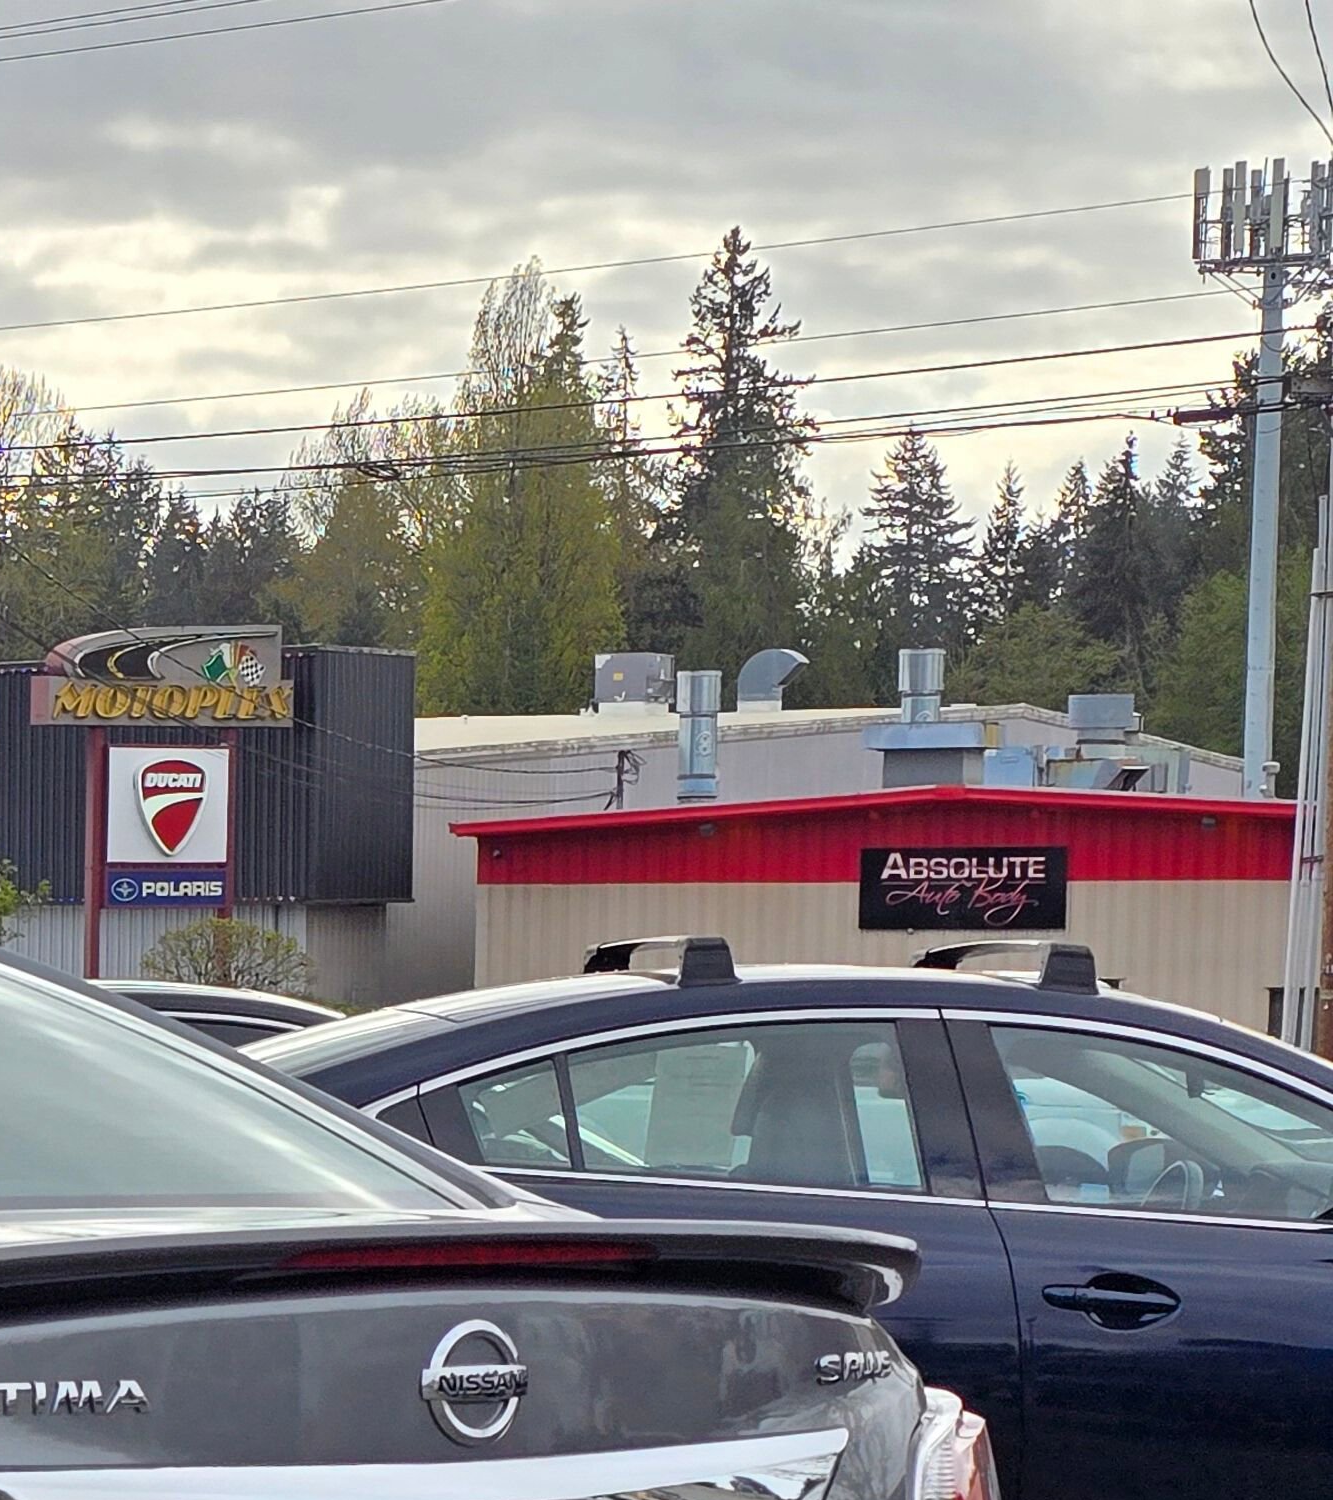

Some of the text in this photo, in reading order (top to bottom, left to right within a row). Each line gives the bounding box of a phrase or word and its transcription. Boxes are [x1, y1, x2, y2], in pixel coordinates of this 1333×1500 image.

[52, 681, 293, 720] MOTOPLEX
[144, 773, 202, 788] DUCATI
[142, 881, 223, 897] POLARIS
[885, 868, 1039, 926] Auto Body
[438, 1369, 528, 1397] NISSAN
